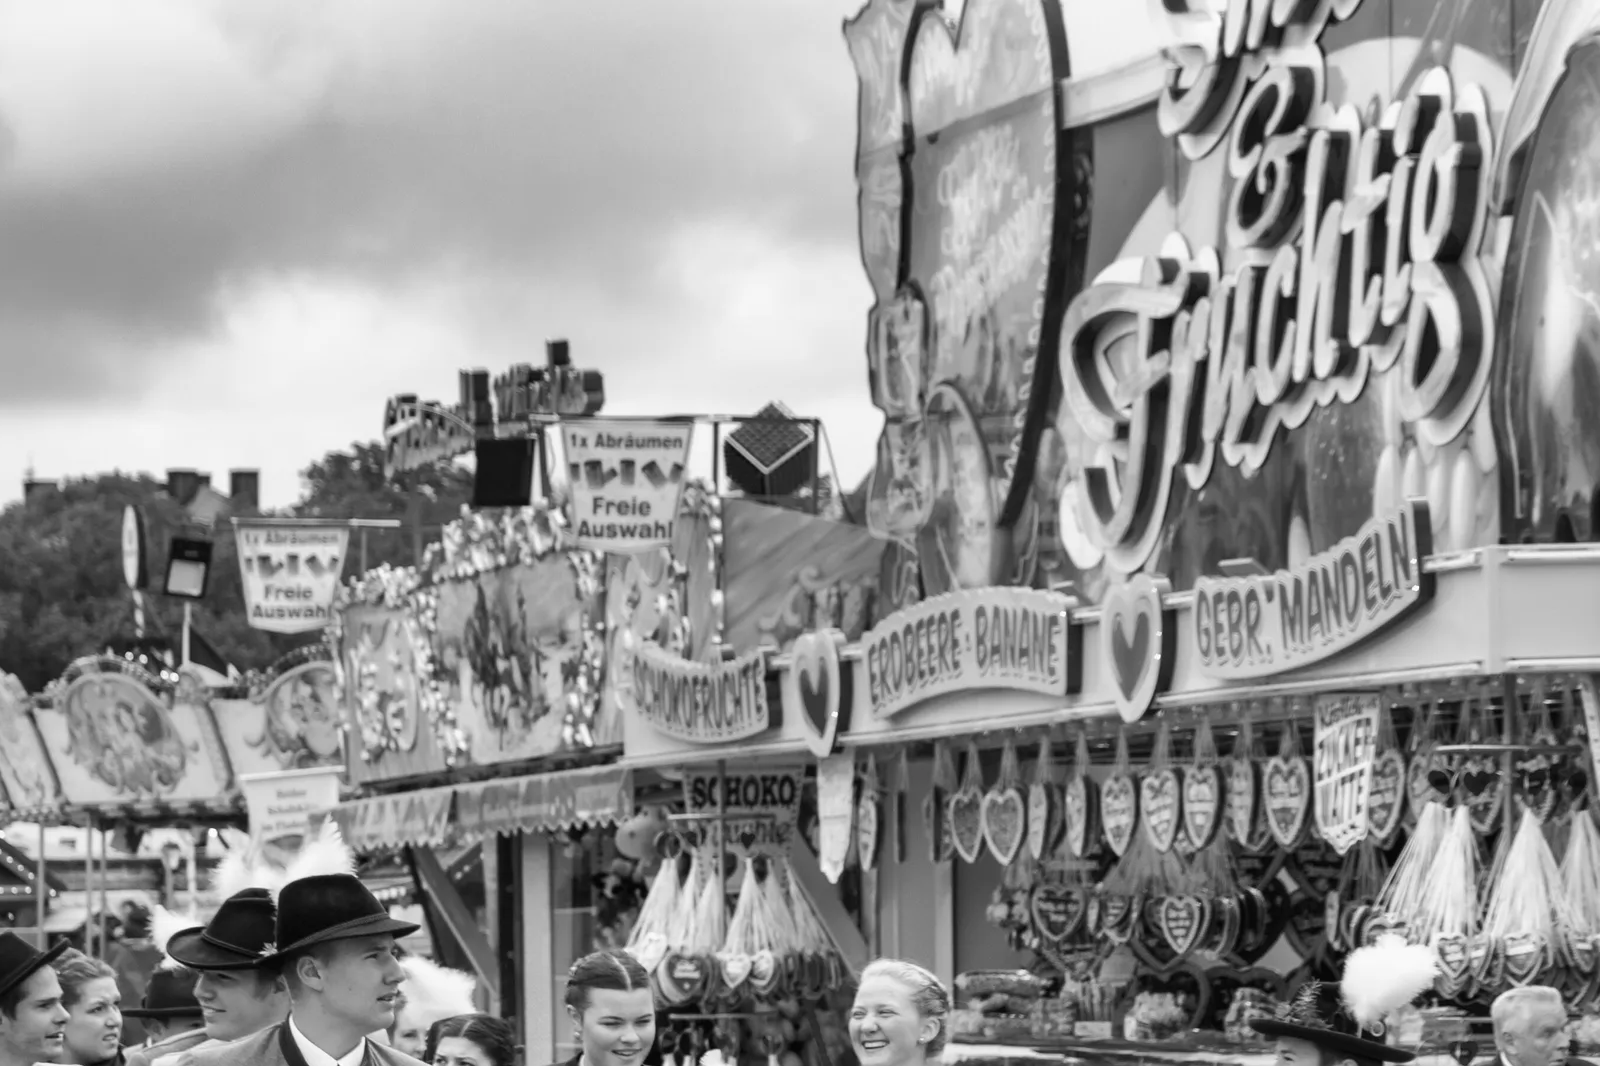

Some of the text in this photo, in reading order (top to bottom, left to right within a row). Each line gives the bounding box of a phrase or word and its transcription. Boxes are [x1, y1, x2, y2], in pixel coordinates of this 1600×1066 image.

[571, 433, 683, 448] 1x Abräumen
[592, 497, 652, 516] Freie
[578, 520, 674, 539] Auswahl
[1278, 508, 1412, 652] MANDELN
[264, 584, 313, 600] Freie
[693, 774, 796, 808] SCHOKO
